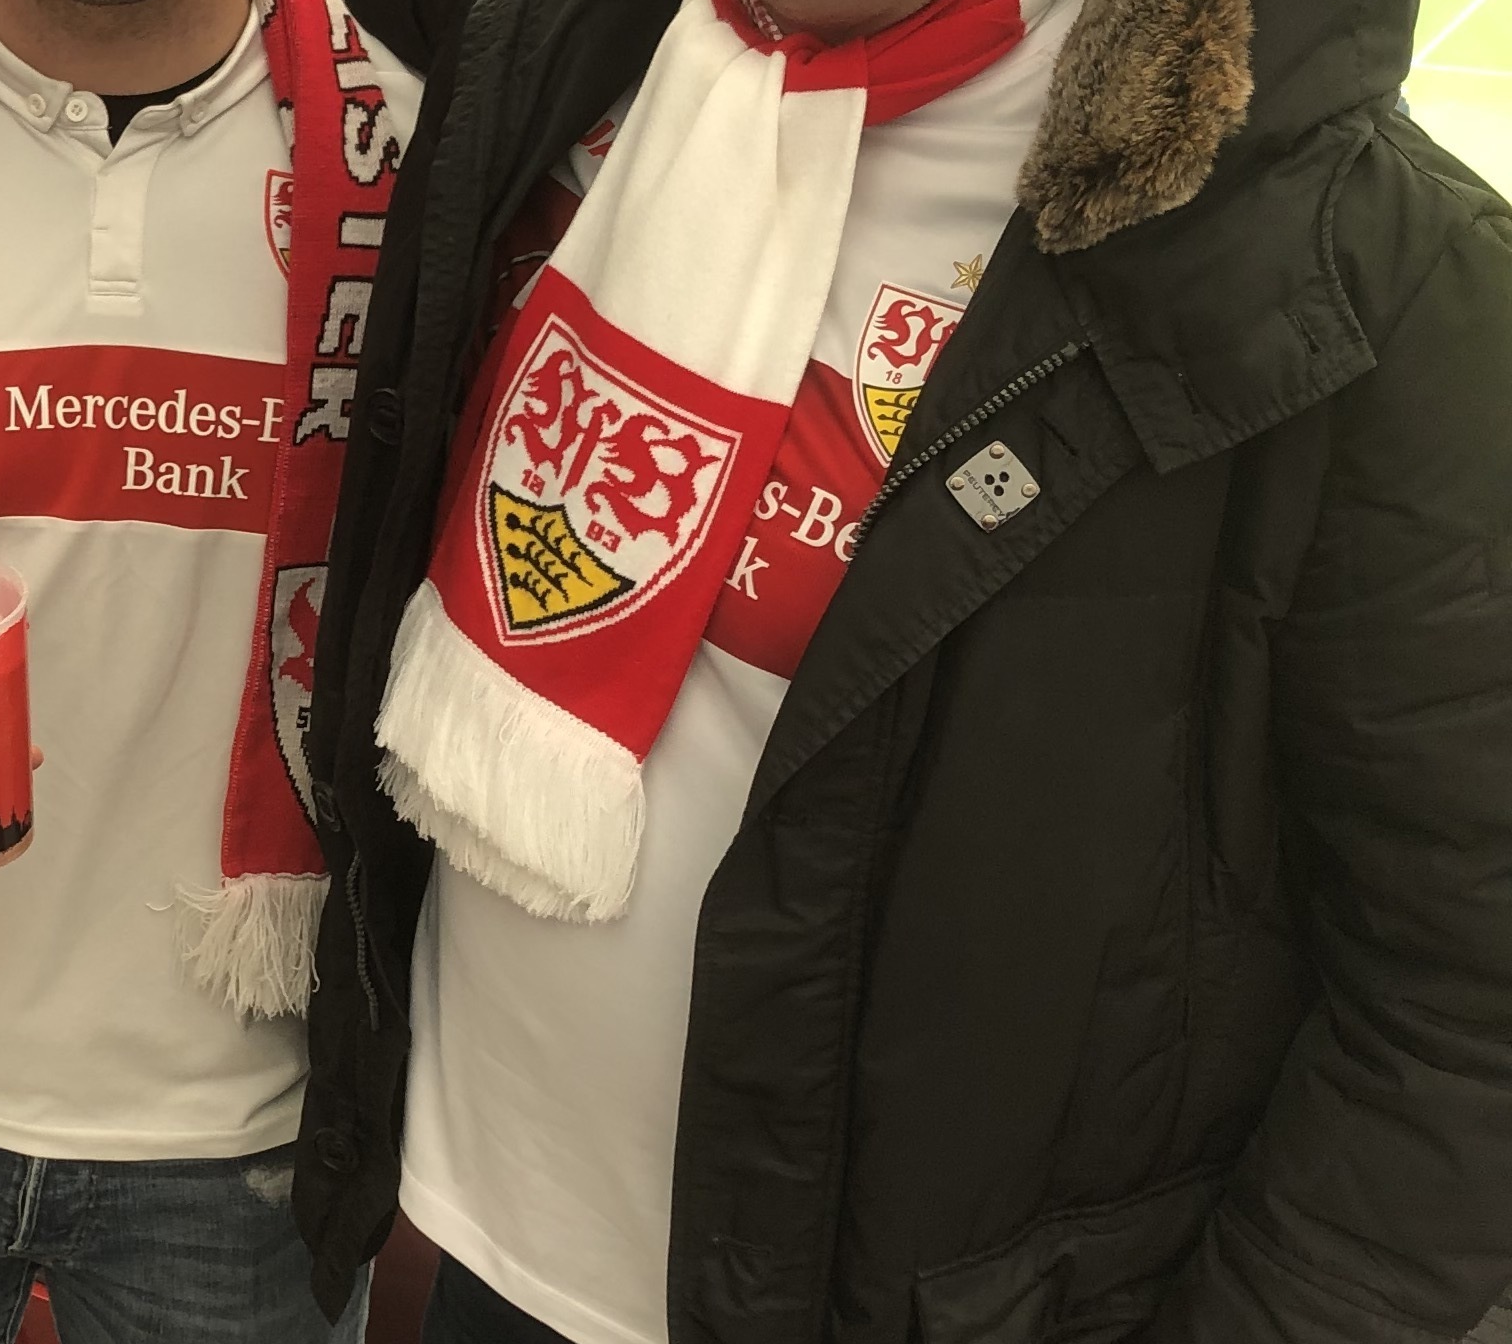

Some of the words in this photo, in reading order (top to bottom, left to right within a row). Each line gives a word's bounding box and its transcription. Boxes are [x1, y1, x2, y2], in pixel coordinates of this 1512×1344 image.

[885, 370, 903, 385] 18
[122, 446, 250, 499] Bank
[586, 519, 622, 554] 93
